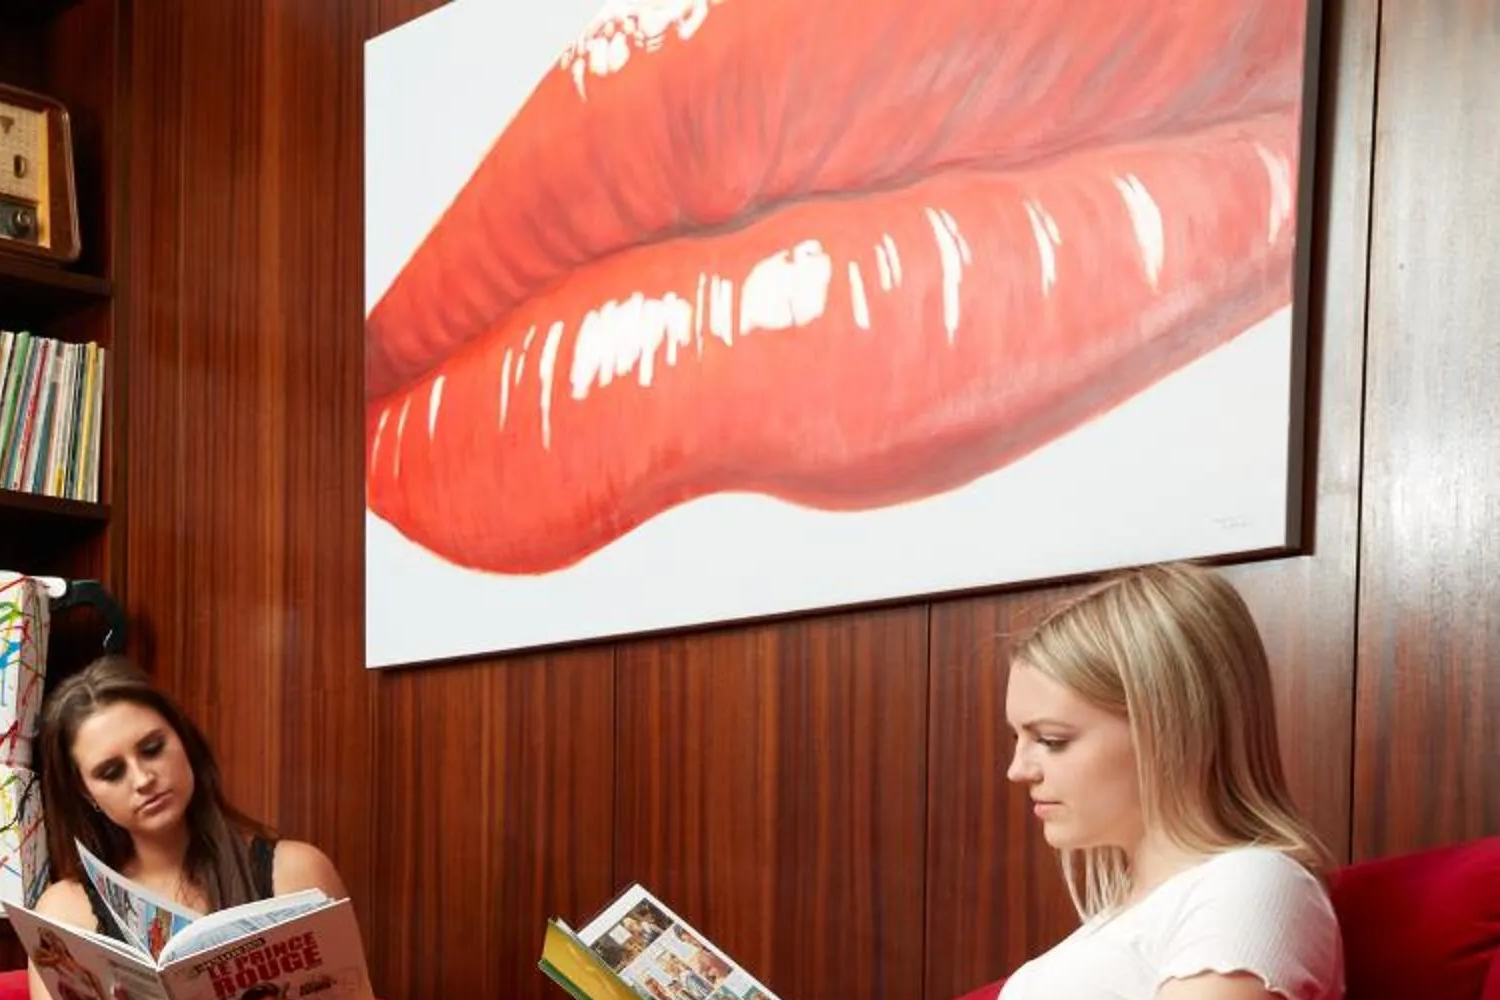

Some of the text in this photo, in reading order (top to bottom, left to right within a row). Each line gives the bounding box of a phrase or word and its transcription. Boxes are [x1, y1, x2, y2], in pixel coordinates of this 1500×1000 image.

[207, 957, 232, 979] LE
[235, 931, 319, 969] PRINCE
[212, 949, 323, 999] ROUGE
